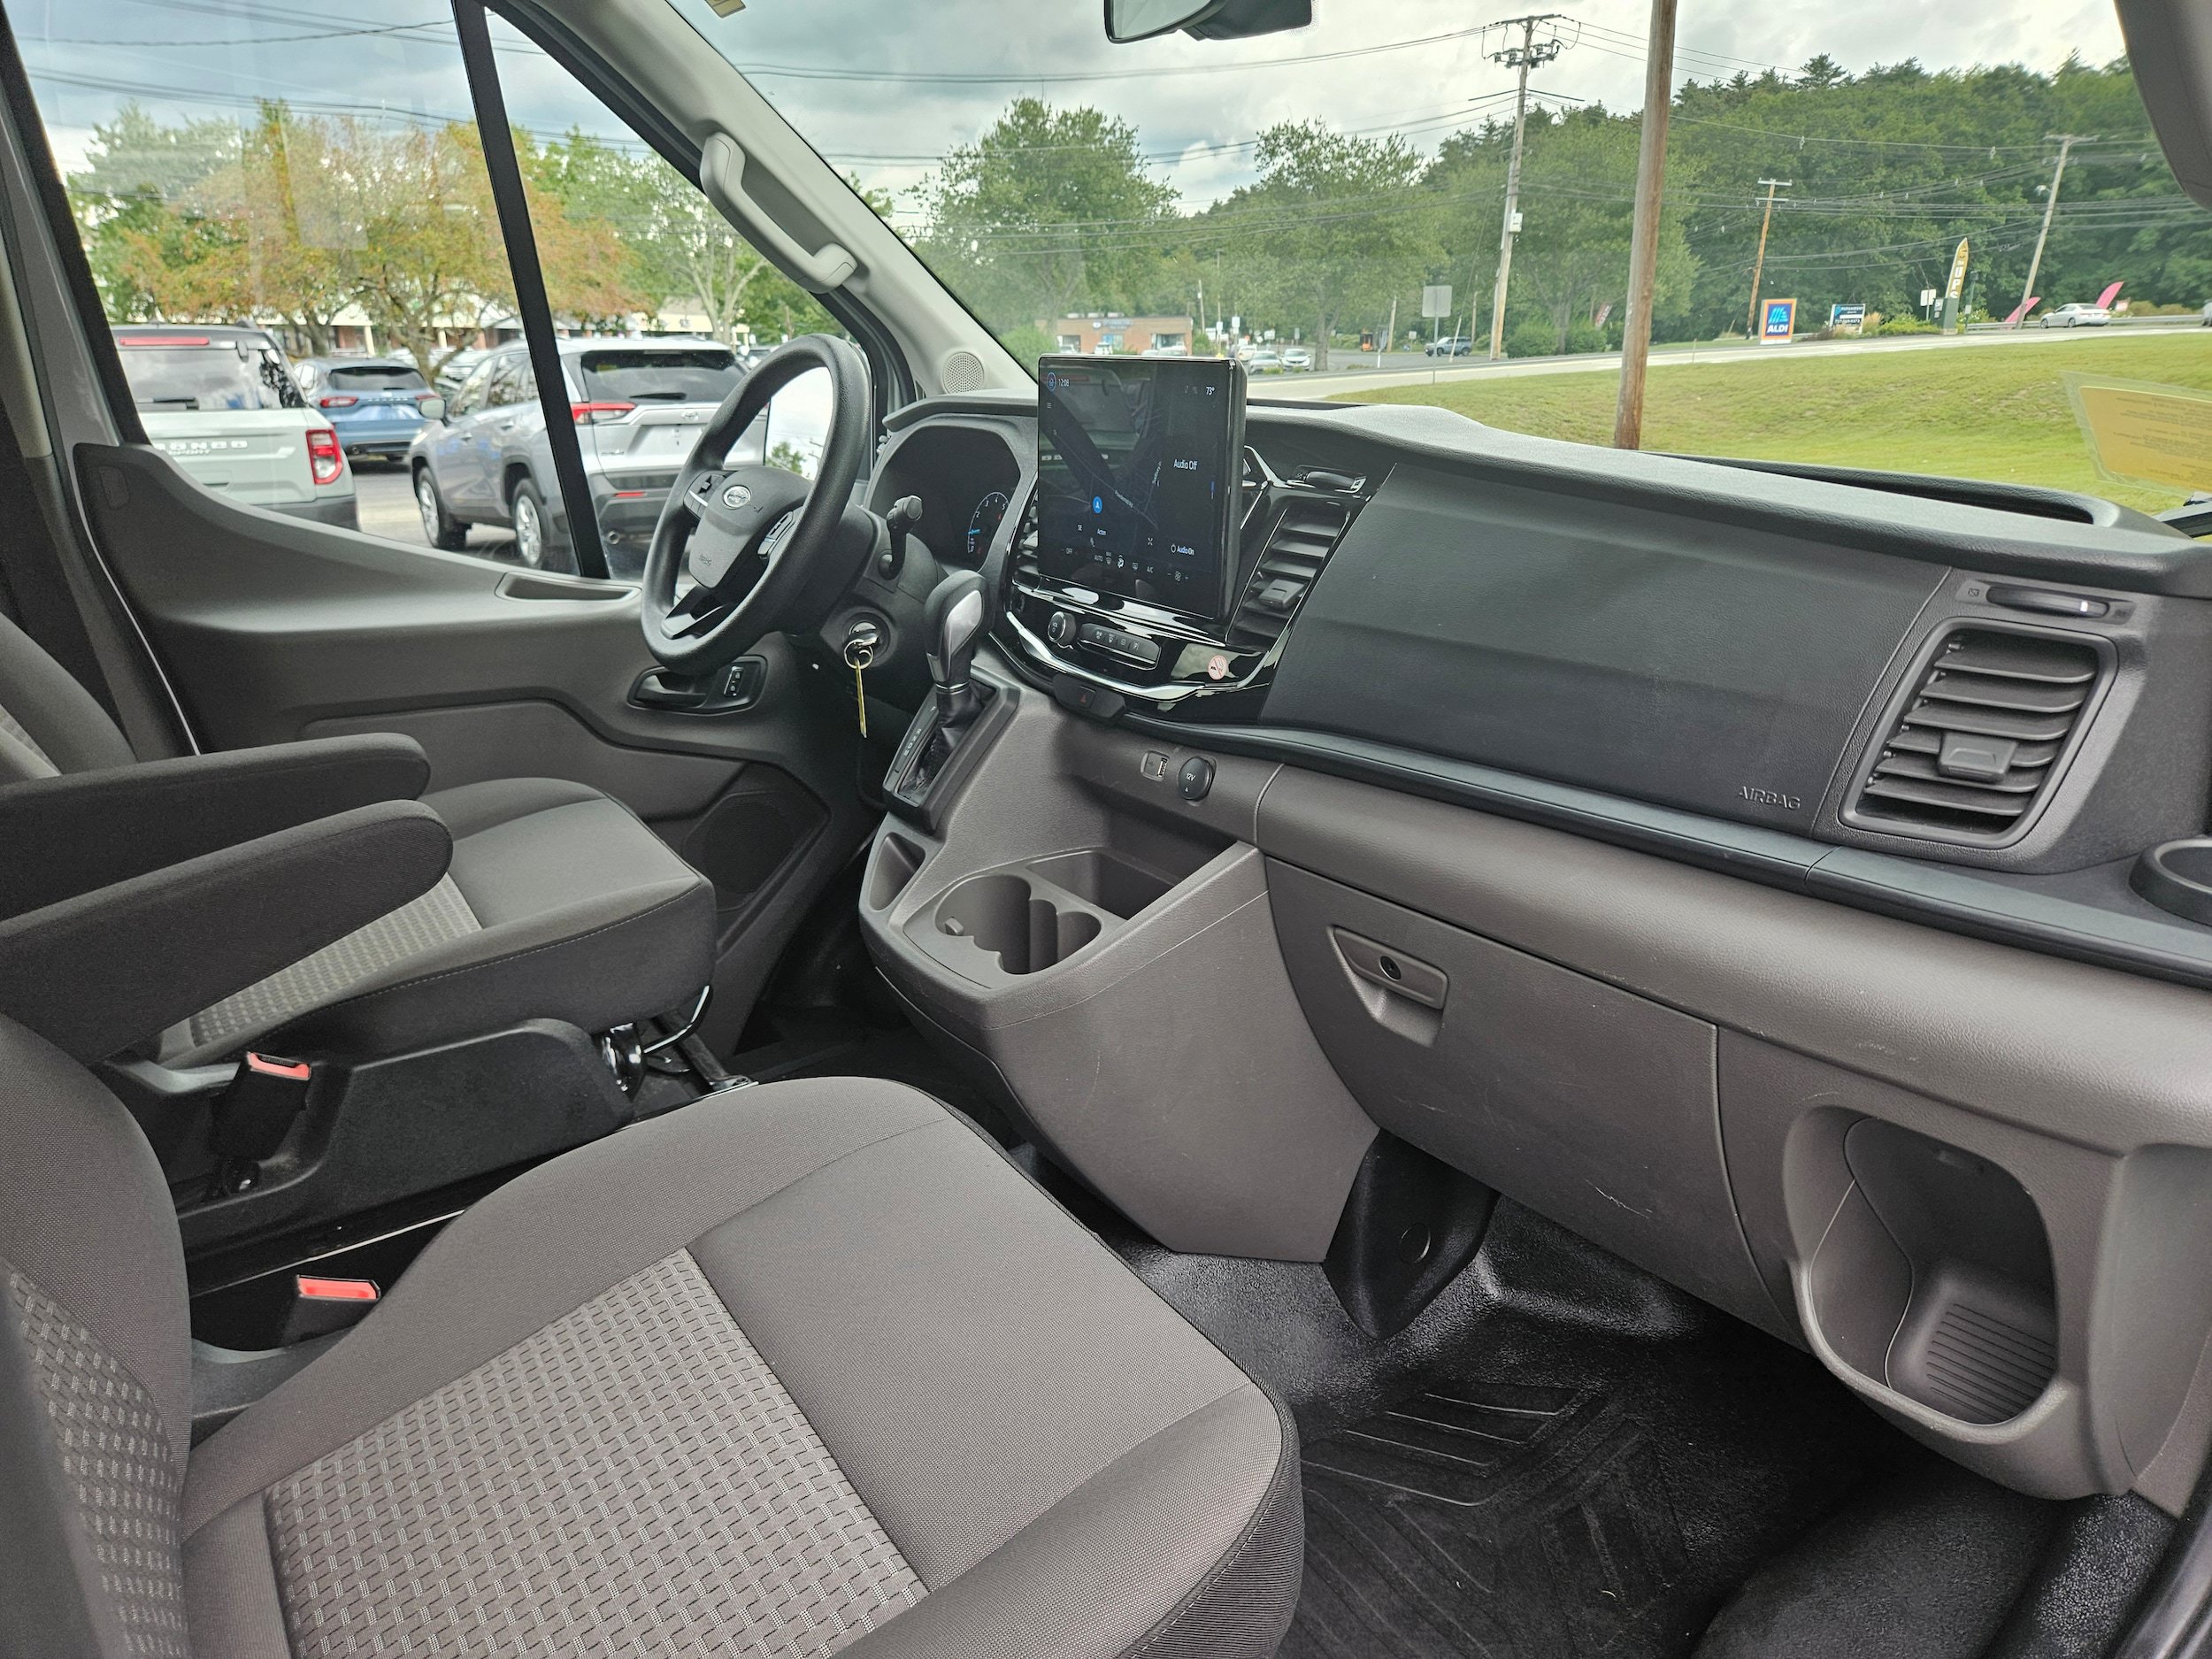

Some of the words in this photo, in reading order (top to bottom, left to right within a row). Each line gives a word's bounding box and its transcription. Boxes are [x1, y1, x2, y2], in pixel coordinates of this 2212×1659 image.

[1767, 324, 1789, 334] ALDI
[1173, 459, 1189, 470] Audio
[1188, 460, 1198, 471] Off
[1177, 545, 1188, 555] Audio
[1187, 547, 1195, 556] On
[1186, 772, 1196, 781] 12V
[1738, 785, 1801, 810] AIRBAG
